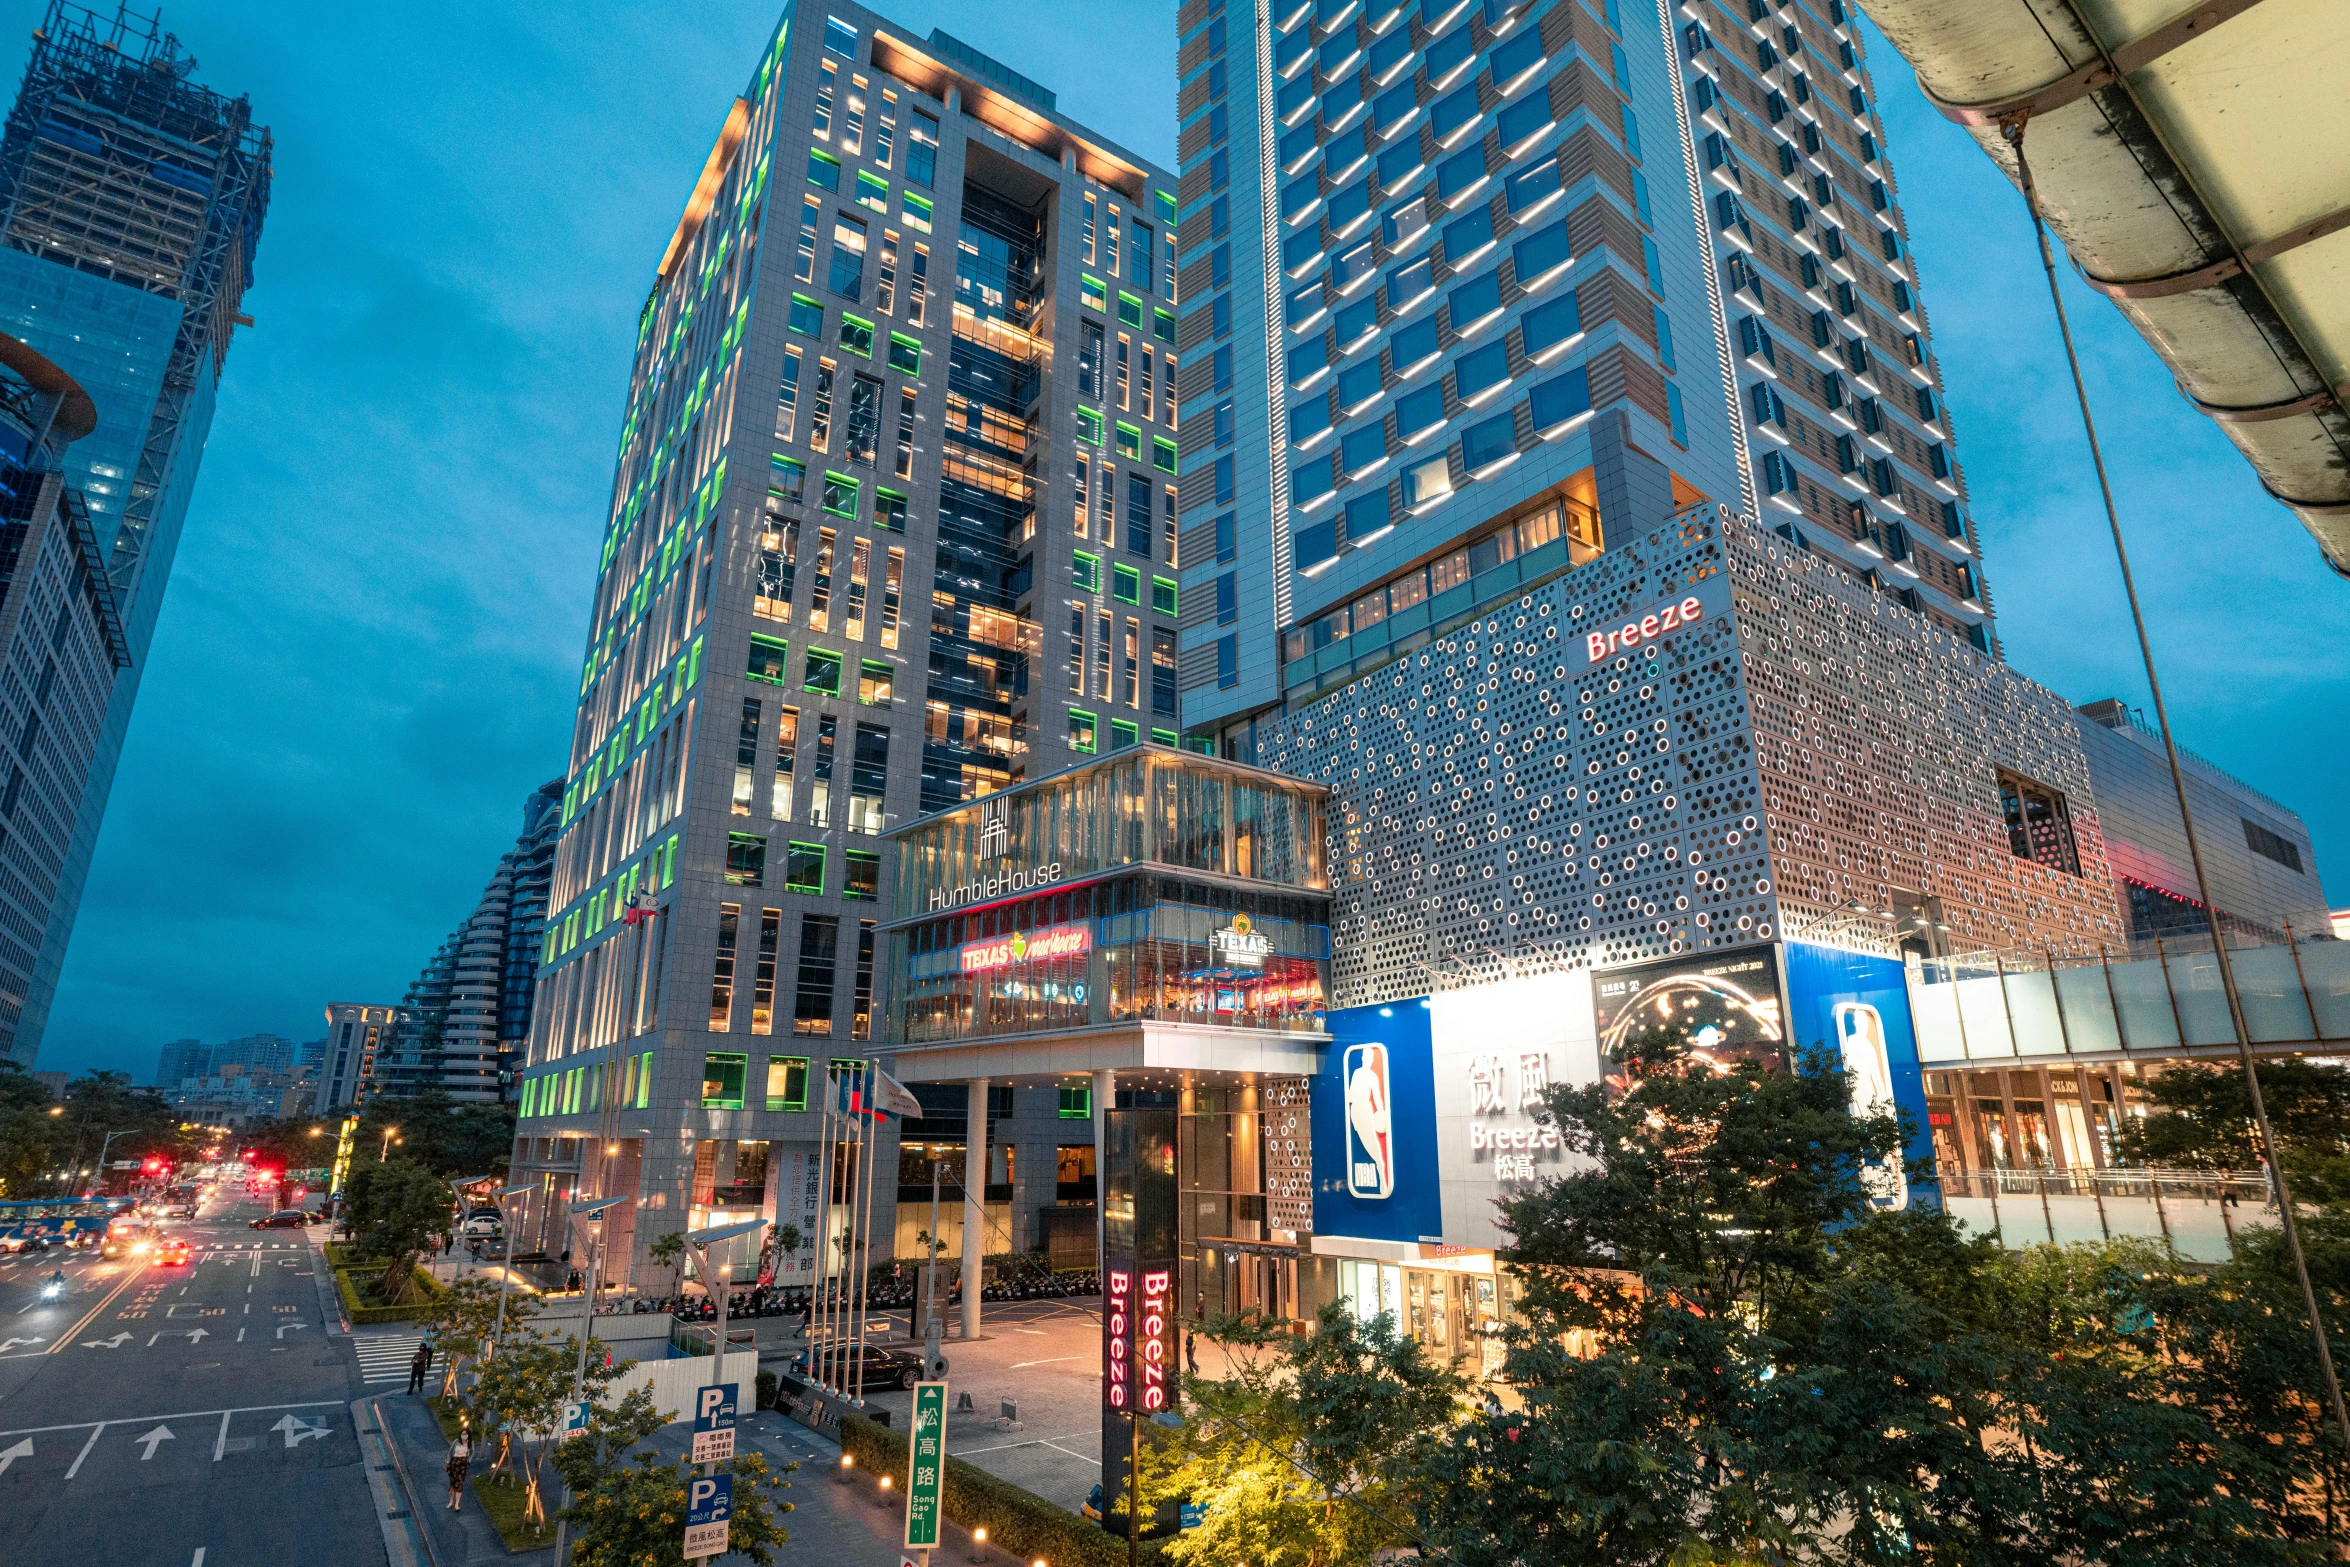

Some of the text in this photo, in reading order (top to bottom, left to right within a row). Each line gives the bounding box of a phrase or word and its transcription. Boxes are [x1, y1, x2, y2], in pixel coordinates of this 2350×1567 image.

[1586, 596, 1703, 663] Breeze
[930, 862, 1061, 911] HumbleHouse
[1218, 933, 1268, 954] TEXAS
[963, 944, 1009, 970] TEXAS
[1468, 1052, 1552, 1114] 微風
[1469, 1121, 1558, 1149] Breeze
[1354, 1163, 1377, 1187] NBA
[1494, 1154, 1536, 1181] 松高
[784, 1153, 803, 1272] 為您提供全方位服務
[1436, 1245, 1466, 1256] Breeze
[116, 1311, 147, 1320] 50
[199, 1307, 226, 1317] 50
[271, 1305, 297, 1313] 50
[1110, 1271, 1131, 1407] Breeze
[1143, 1271, 1168, 1409] Breeze
[701, 1389, 724, 1418] P
[562, 1405, 582, 1430] P
[718, 1419, 734, 1427] 150m
[917, 1407, 938, 1486] 松高路
[690, 1479, 716, 1510] P
[913, 1495, 935, 1504] Song
[690, 1511, 710, 1522] 20公尺
[911, 1512, 925, 1520] Rd.
[912, 1503, 929, 1512] Gao
[686, 1544, 704, 1552] BREEZE
[690, 1529, 724, 1544] 微風松高
